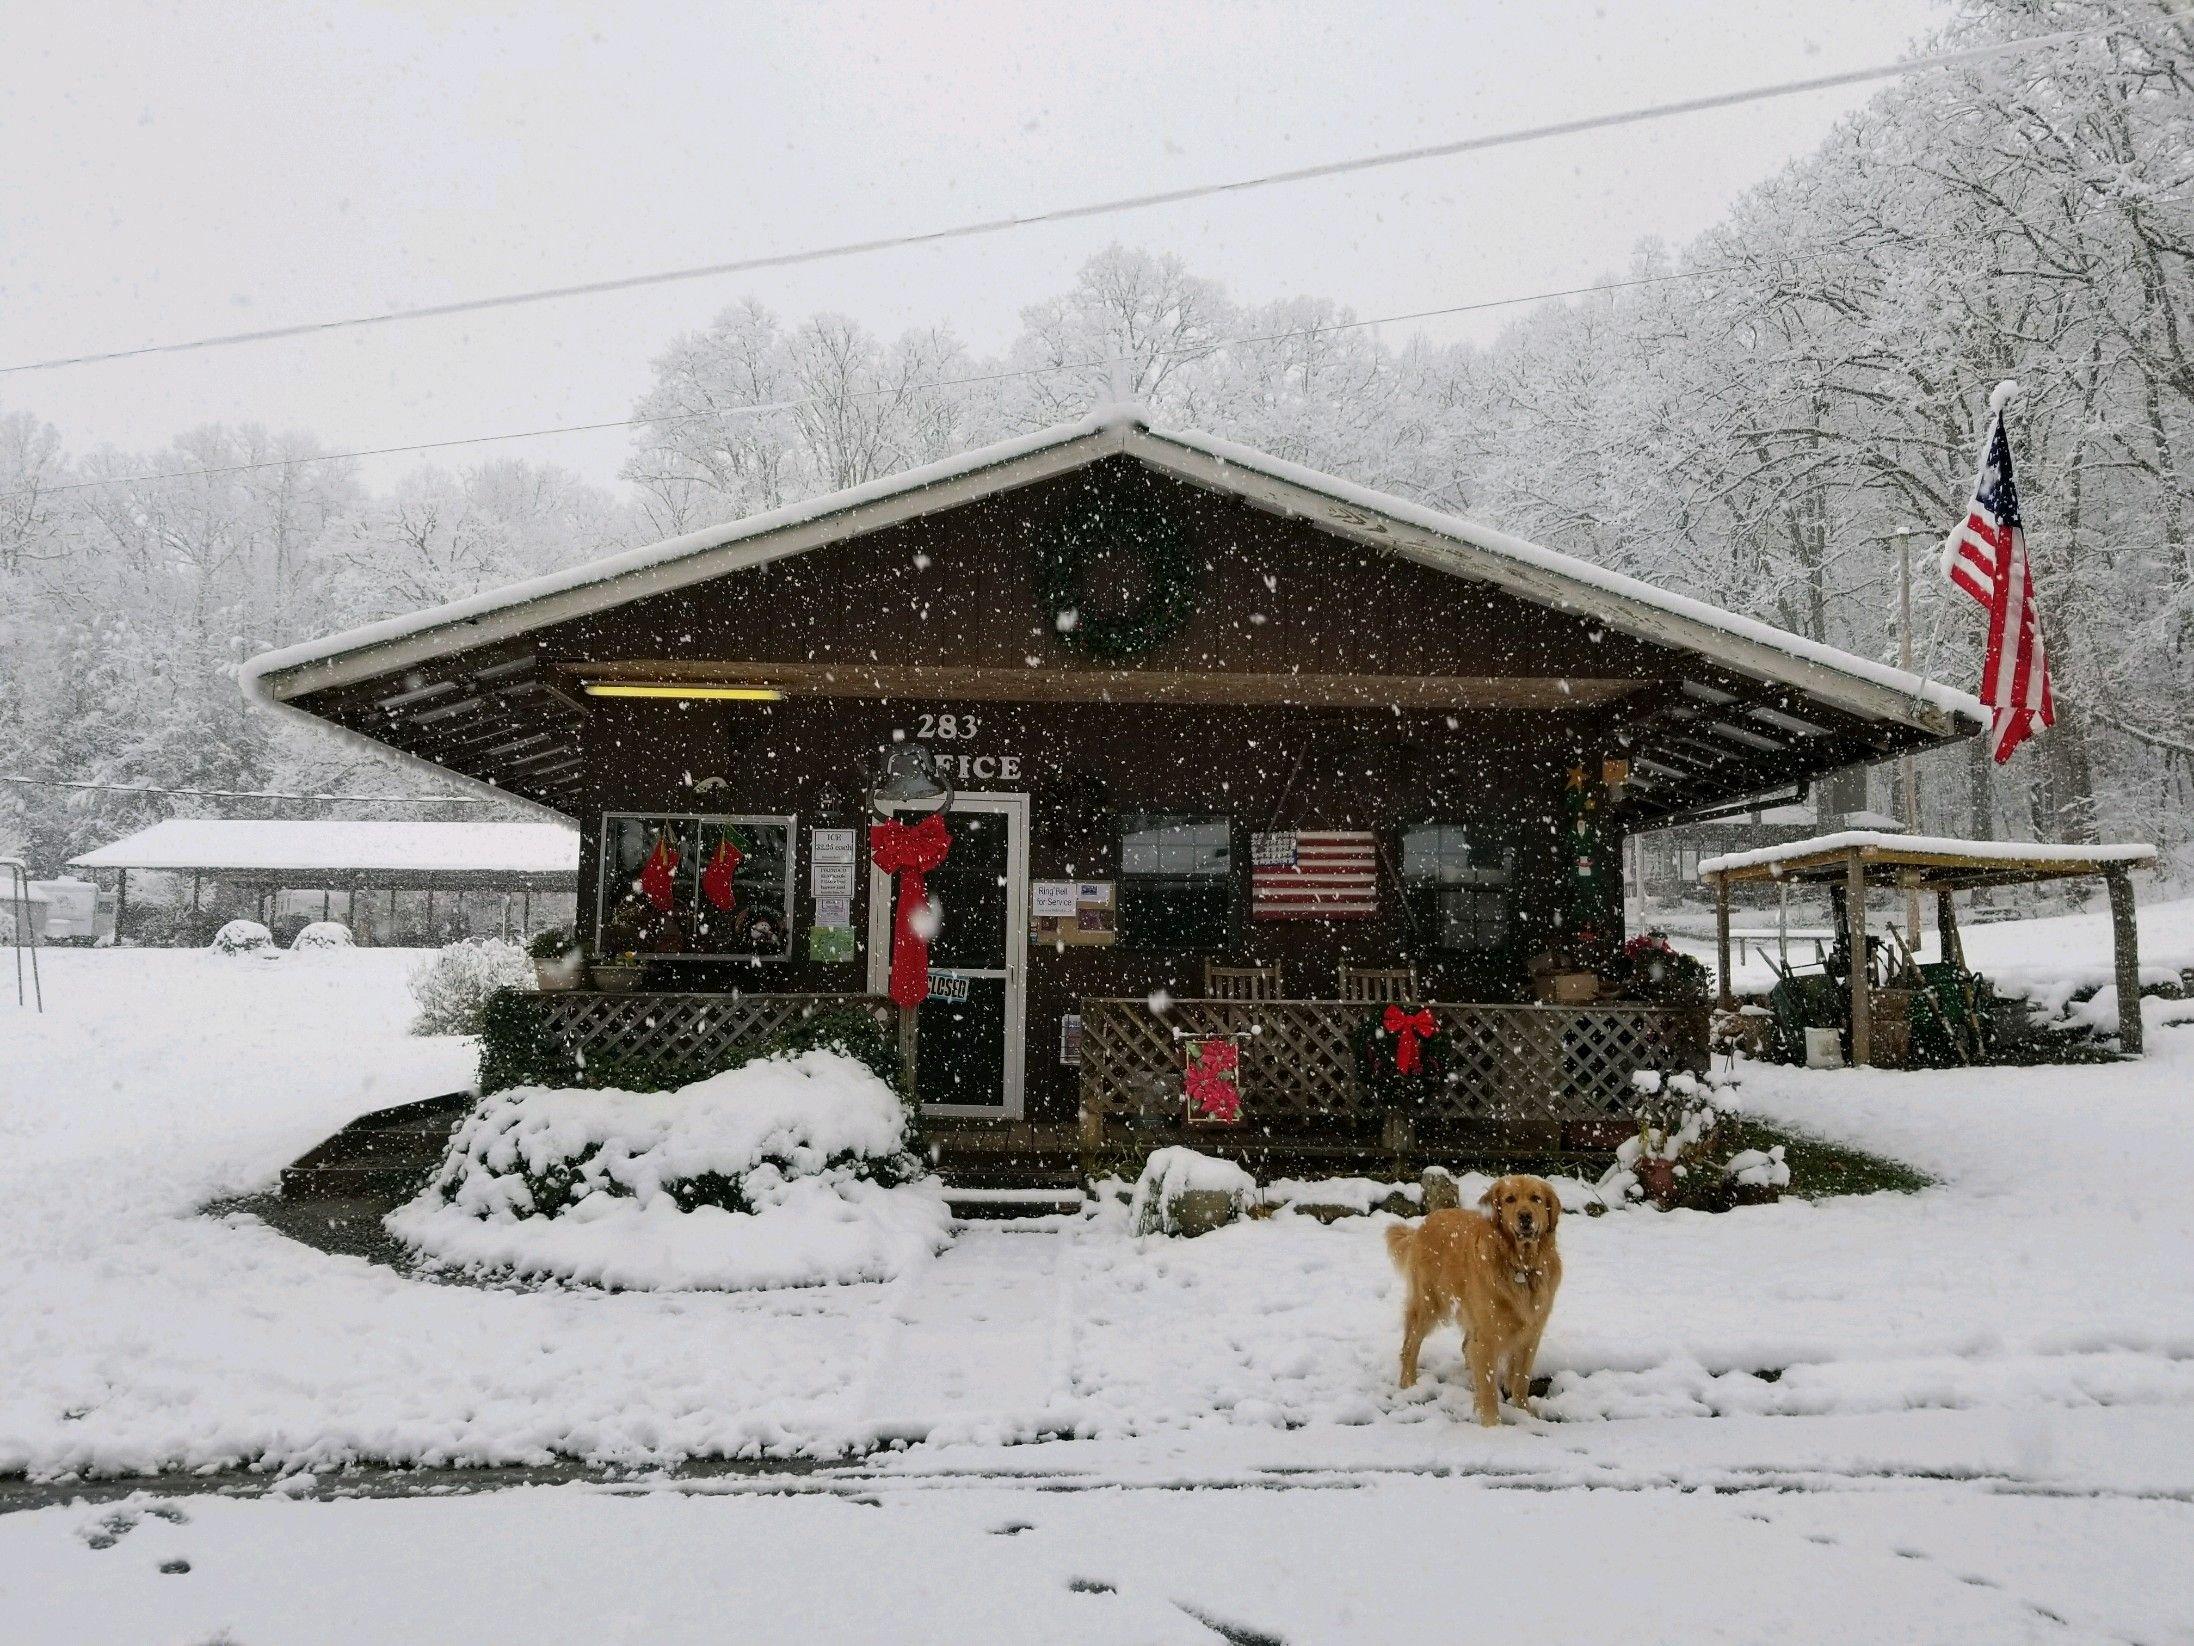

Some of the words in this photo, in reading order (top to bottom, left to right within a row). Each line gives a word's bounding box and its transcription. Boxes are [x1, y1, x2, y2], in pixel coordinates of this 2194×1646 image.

[917, 714, 977, 738] 283
[887, 754, 1022, 779] FICE
[1038, 887, 1053, 896] Ring
[1037, 897, 1046, 906] for
[1047, 897, 1072, 906] Service
